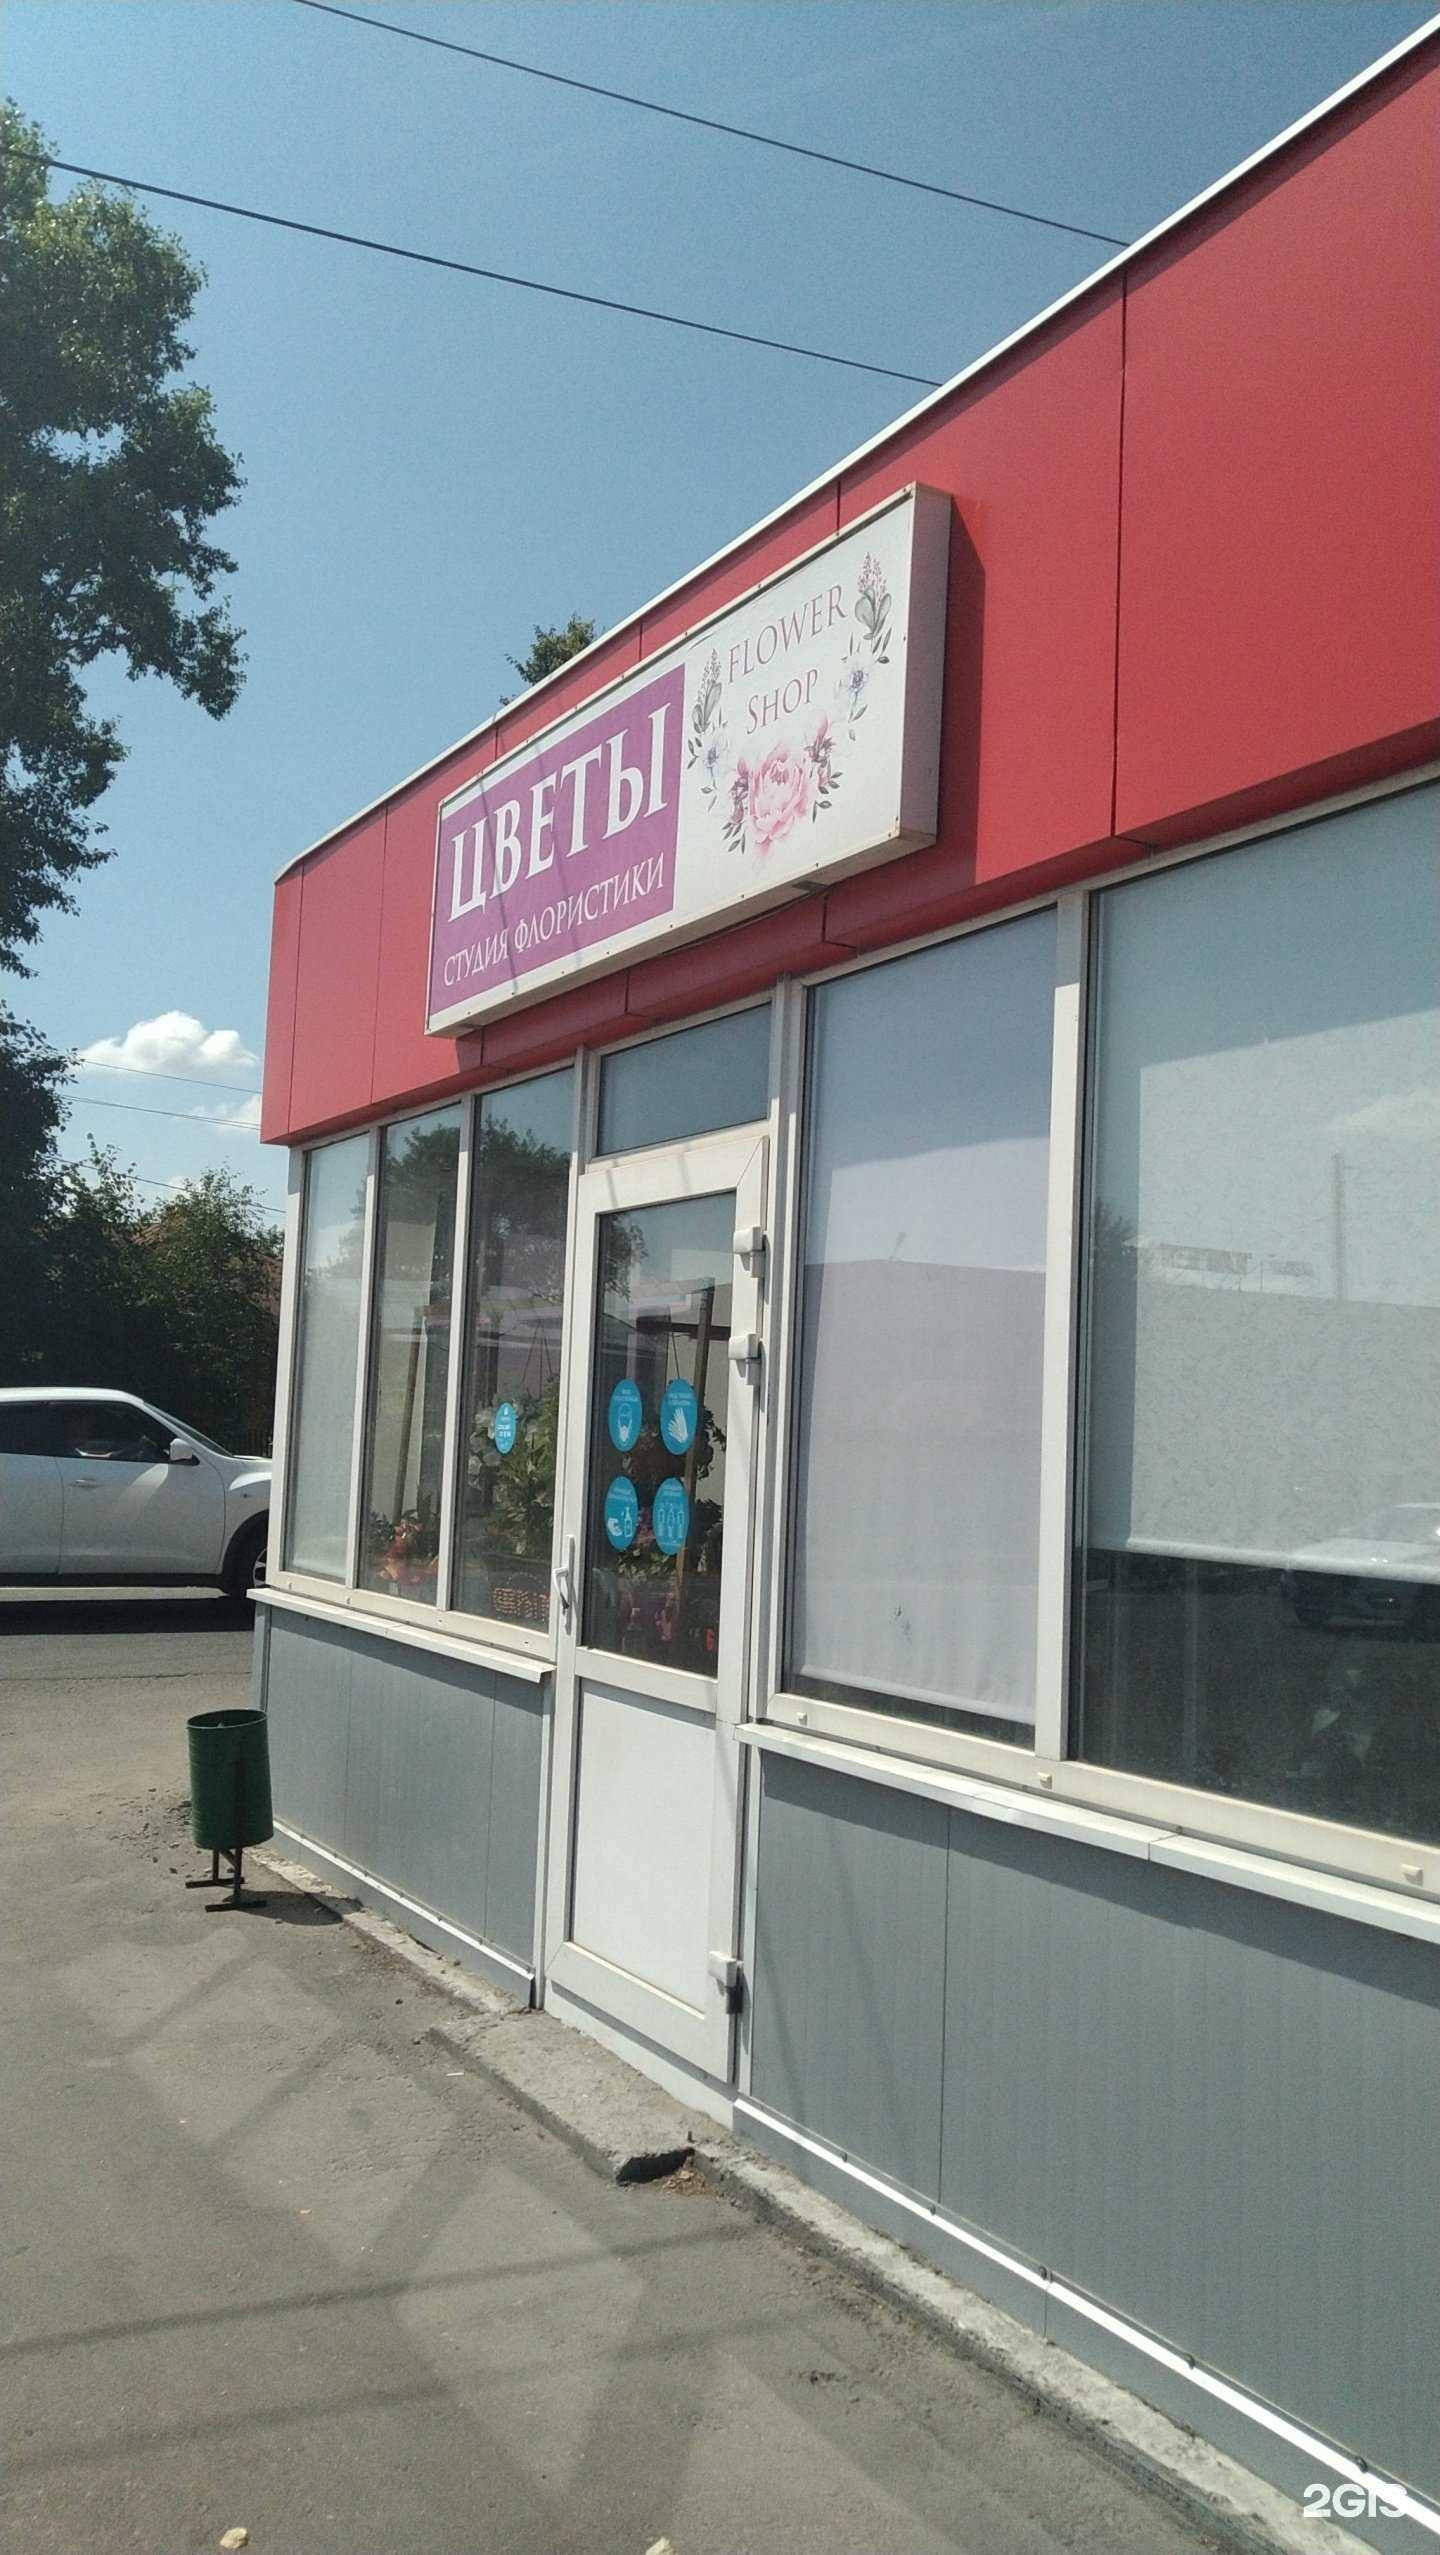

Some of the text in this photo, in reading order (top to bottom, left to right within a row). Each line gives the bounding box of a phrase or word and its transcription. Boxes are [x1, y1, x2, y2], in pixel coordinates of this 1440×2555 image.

[728, 584, 848, 683] FLOWER
[746, 669, 818, 735] SHOP
[447, 701, 672, 923] ЦВЕТЫ
[443, 852, 665, 987] СТУДИЯ ФЛОРИСТИКИ
